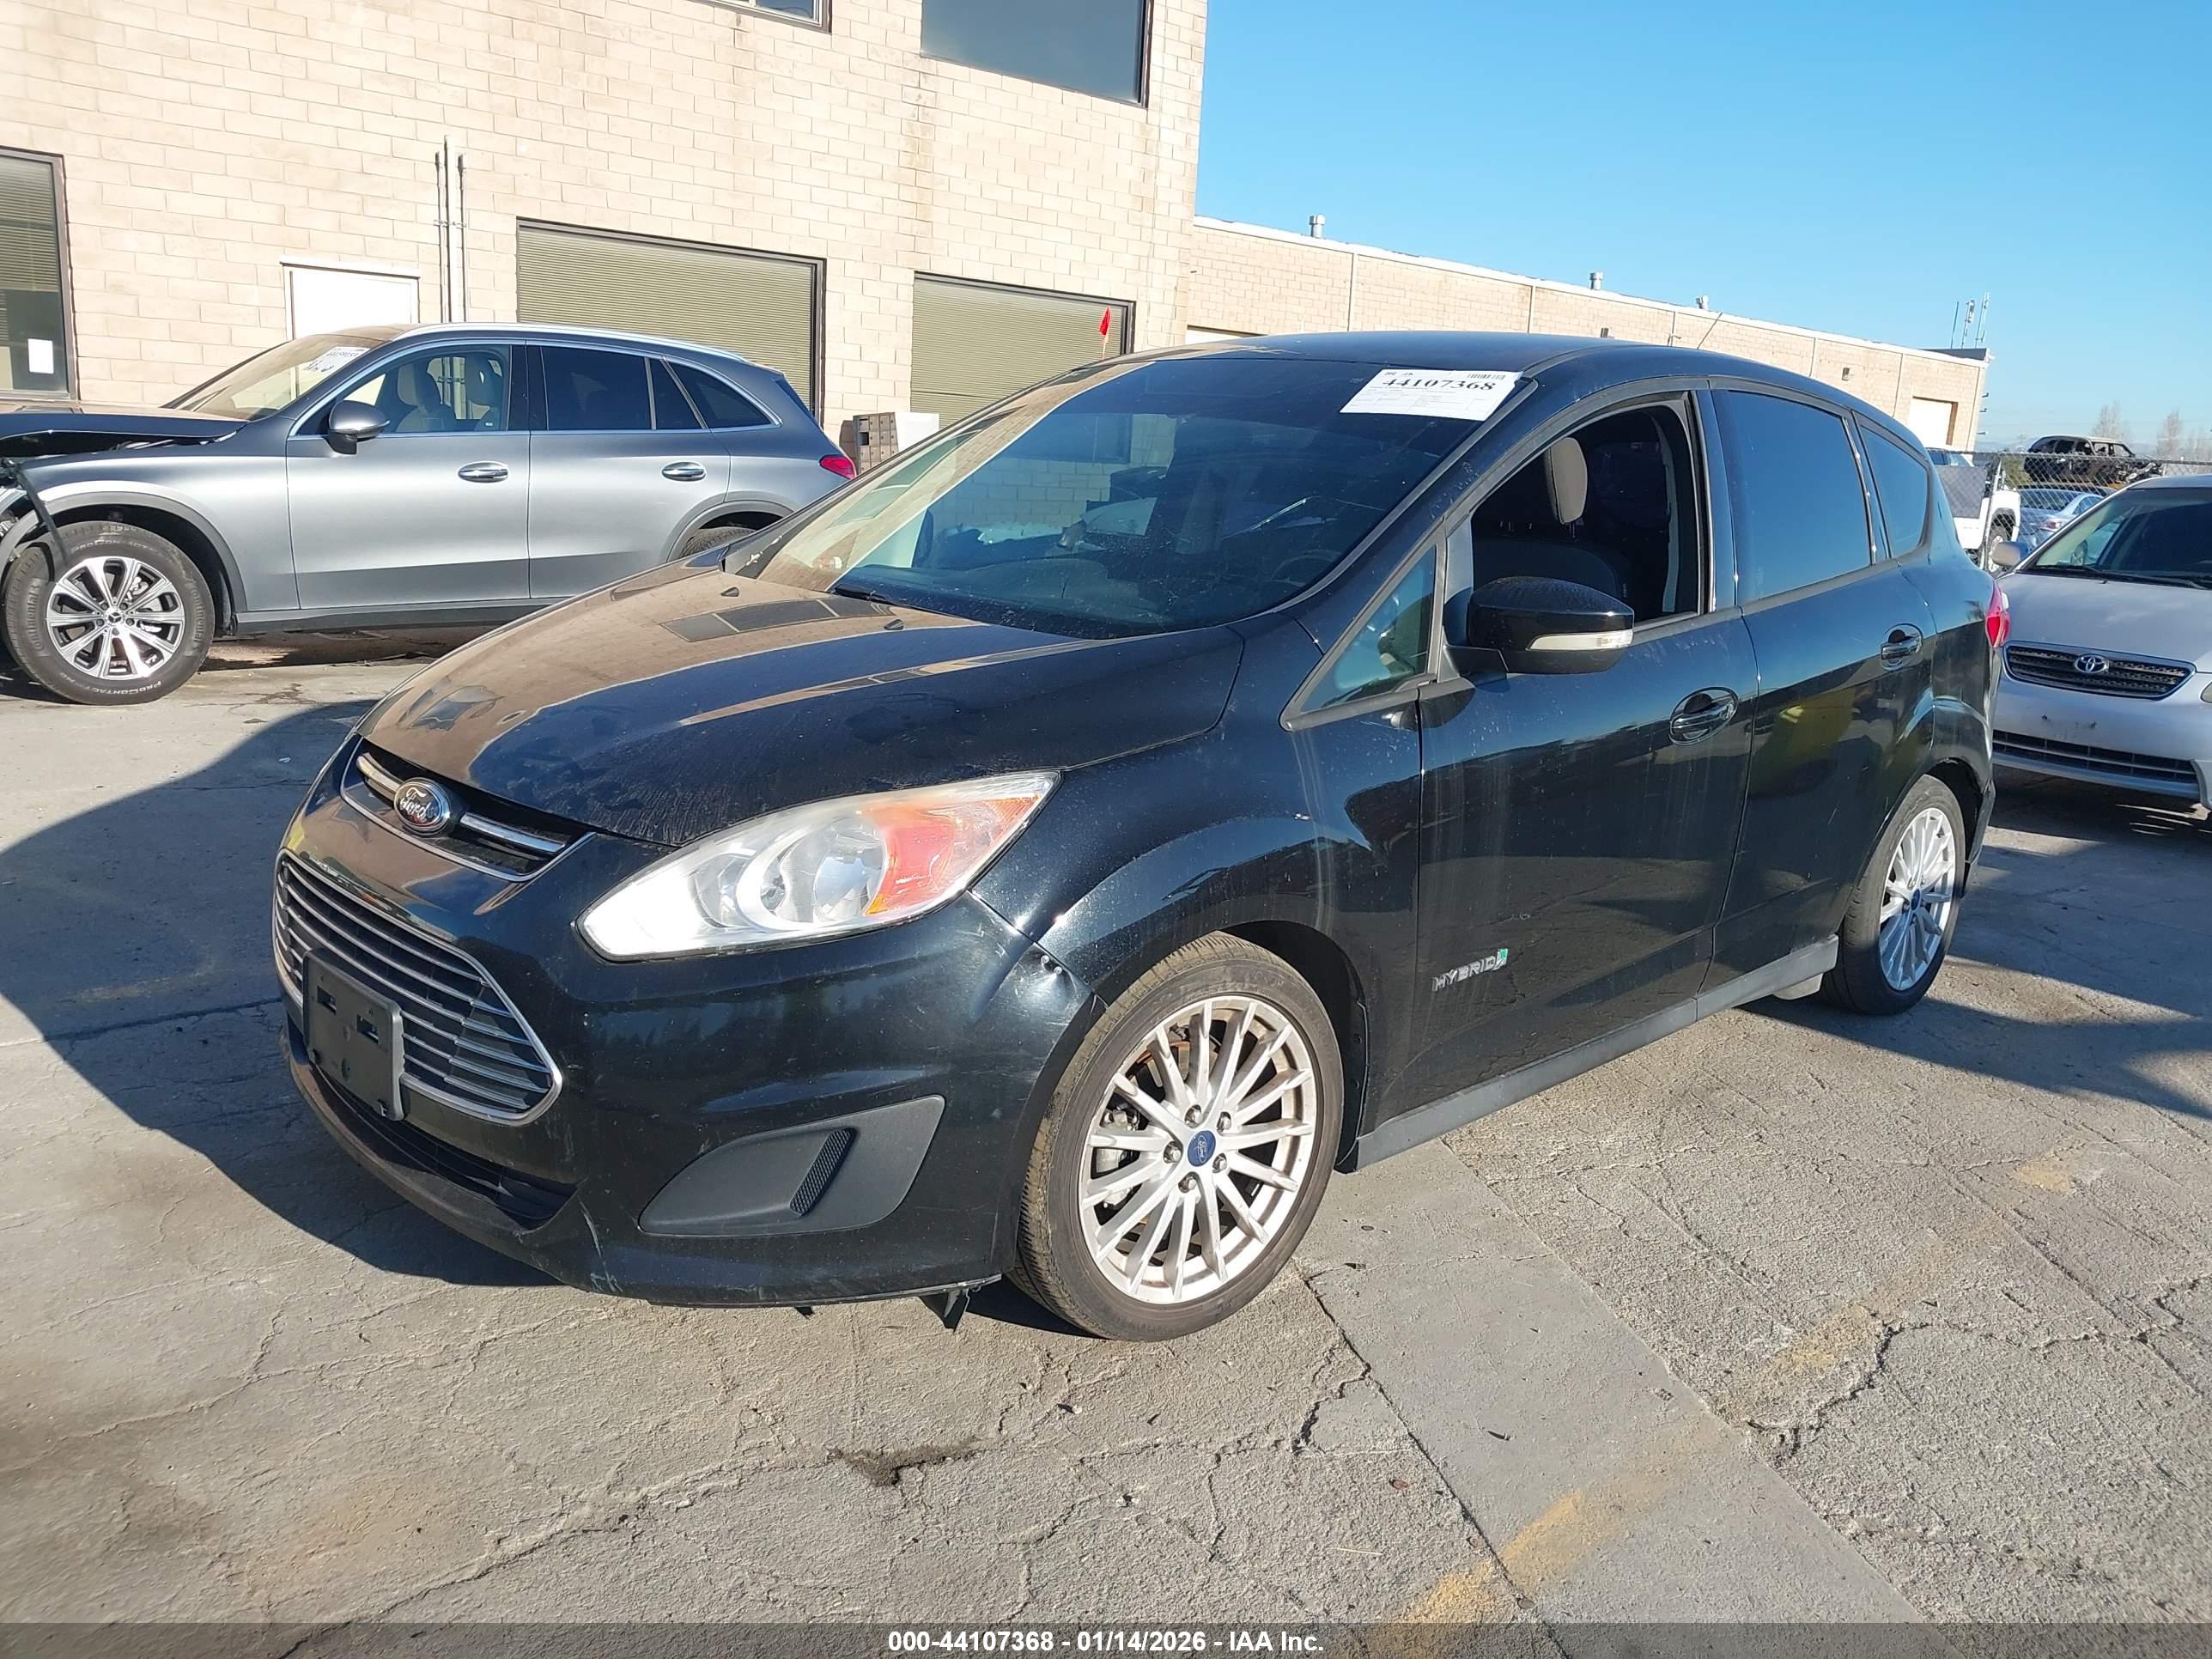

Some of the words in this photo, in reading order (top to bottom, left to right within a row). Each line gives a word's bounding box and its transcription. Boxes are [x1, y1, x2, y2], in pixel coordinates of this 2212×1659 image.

[1382, 378, 1496, 391] 44107368
[400, 787, 432, 822] Ford
[1431, 955, 1497, 992] HYBRID
